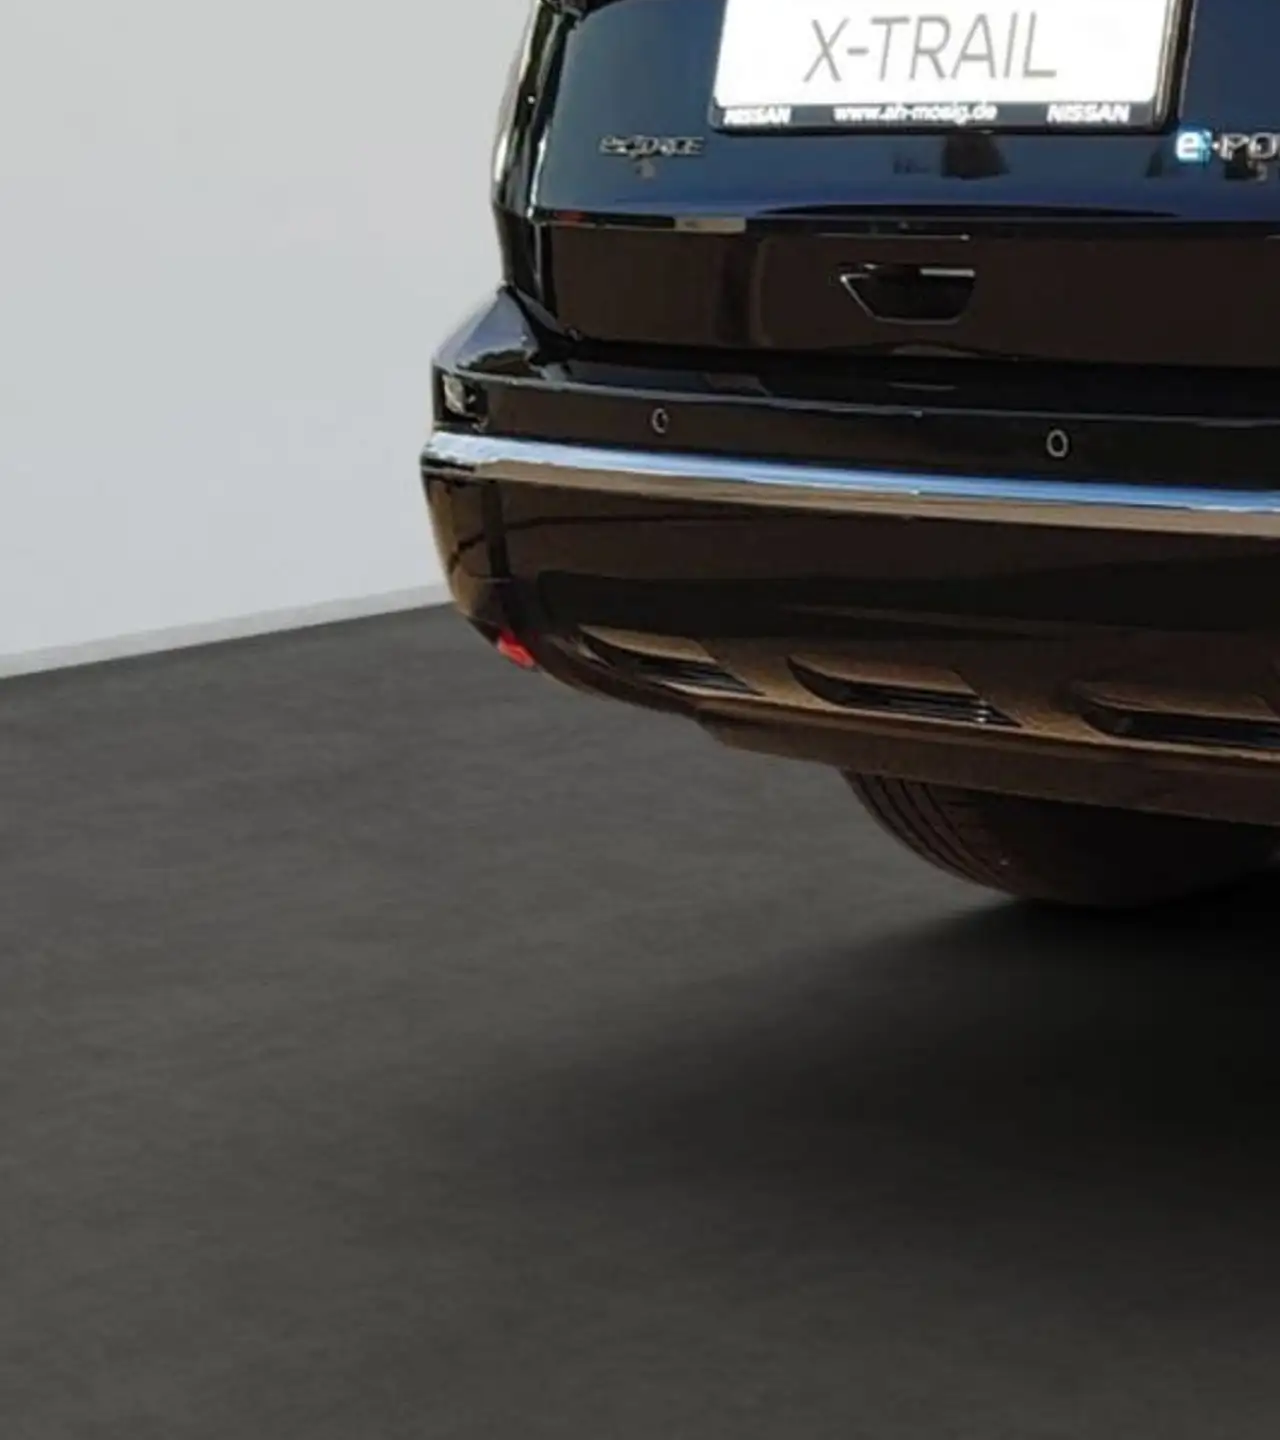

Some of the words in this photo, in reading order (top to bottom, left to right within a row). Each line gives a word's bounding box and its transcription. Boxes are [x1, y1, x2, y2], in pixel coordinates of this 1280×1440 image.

[803, 11, 1057, 82] X-TRAIL
[723, 107, 792, 126] NISSAN
[1046, 103, 1130, 125] NISSAN
